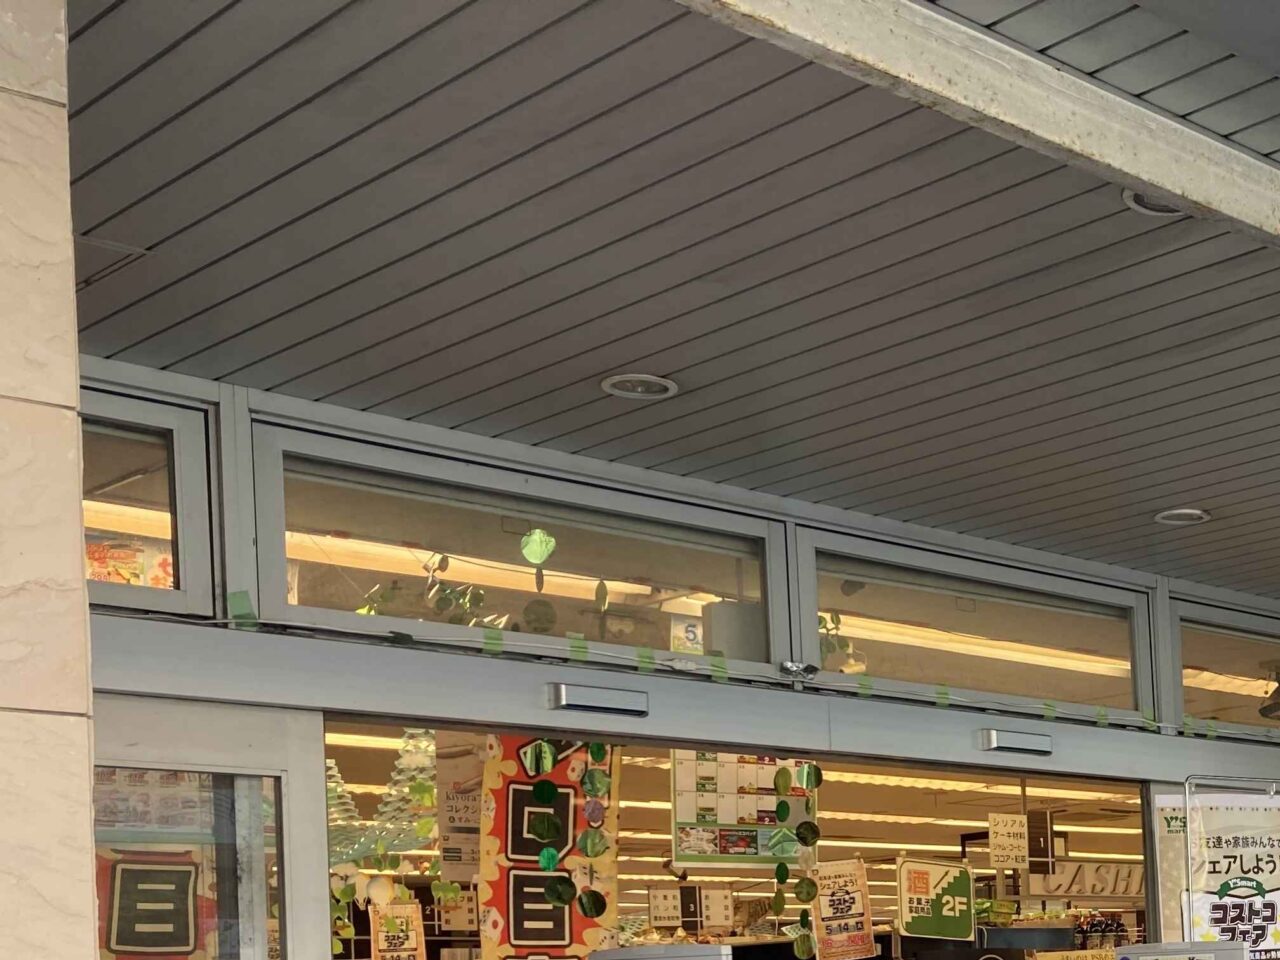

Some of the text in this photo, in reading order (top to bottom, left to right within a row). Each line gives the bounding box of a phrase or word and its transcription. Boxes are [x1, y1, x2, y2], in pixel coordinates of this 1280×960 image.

[993, 818, 1026, 828] シリアル
[992, 831, 1026, 840] ケーキ材料
[1039, 837, 1044, 848] 1
[994, 854, 1027, 863] ココア・紅茶
[907, 869, 931, 896] 酒
[828, 896, 856, 907] コストコ
[908, 897, 931, 907] お菓子
[941, 895, 969, 917] 2F
[424, 906, 432, 915] 2
[689, 903, 695, 912] 3
[832, 906, 852, 915] フェア
[908, 906, 932, 917] 家庭用品
[1209, 900, 1277, 927] コストコ
[1219, 925, 1268, 948] フェア
